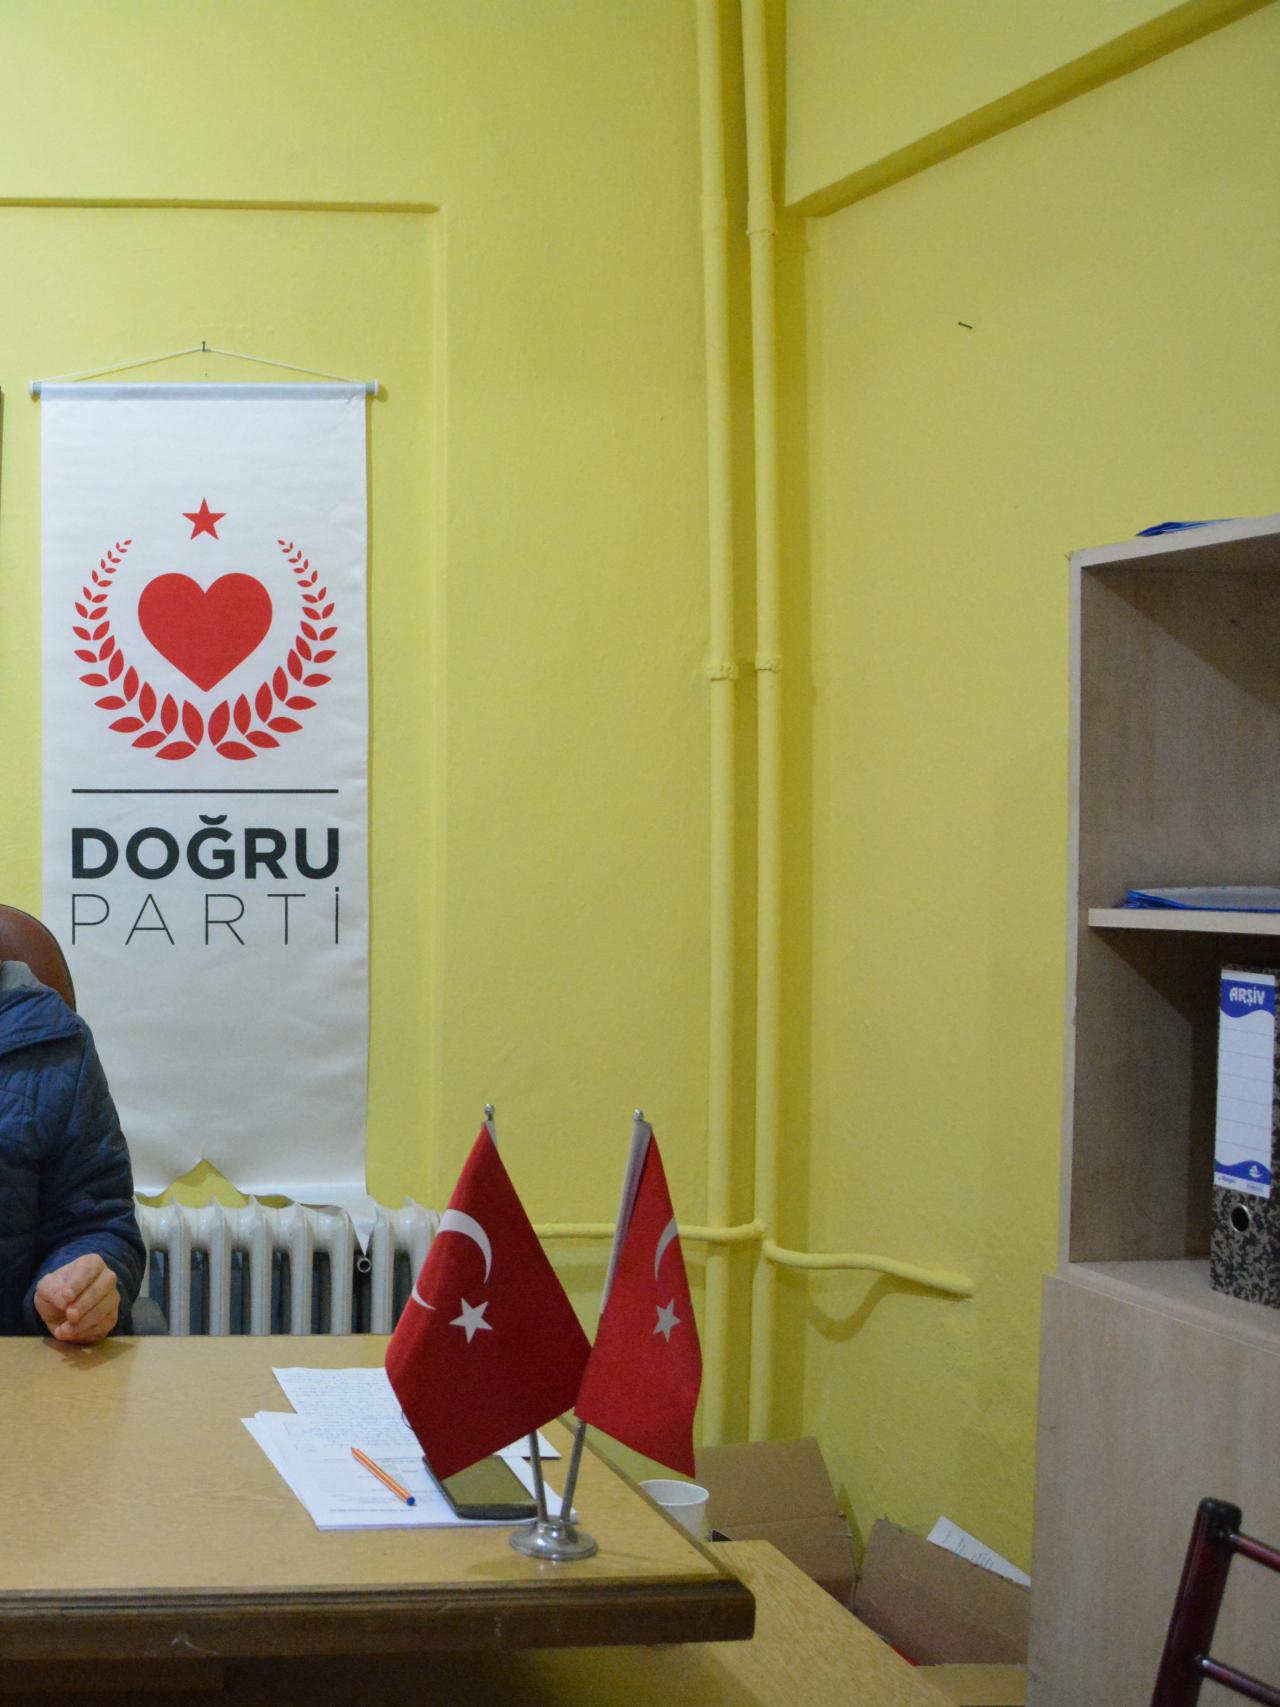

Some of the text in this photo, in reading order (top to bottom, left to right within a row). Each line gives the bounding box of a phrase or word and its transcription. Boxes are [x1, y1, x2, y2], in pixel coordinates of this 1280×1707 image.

[71, 814, 340, 880] DOĞRU
[71, 886, 340, 945] PARTİ
[1229, 986, 1265, 1007] ARŞİV
